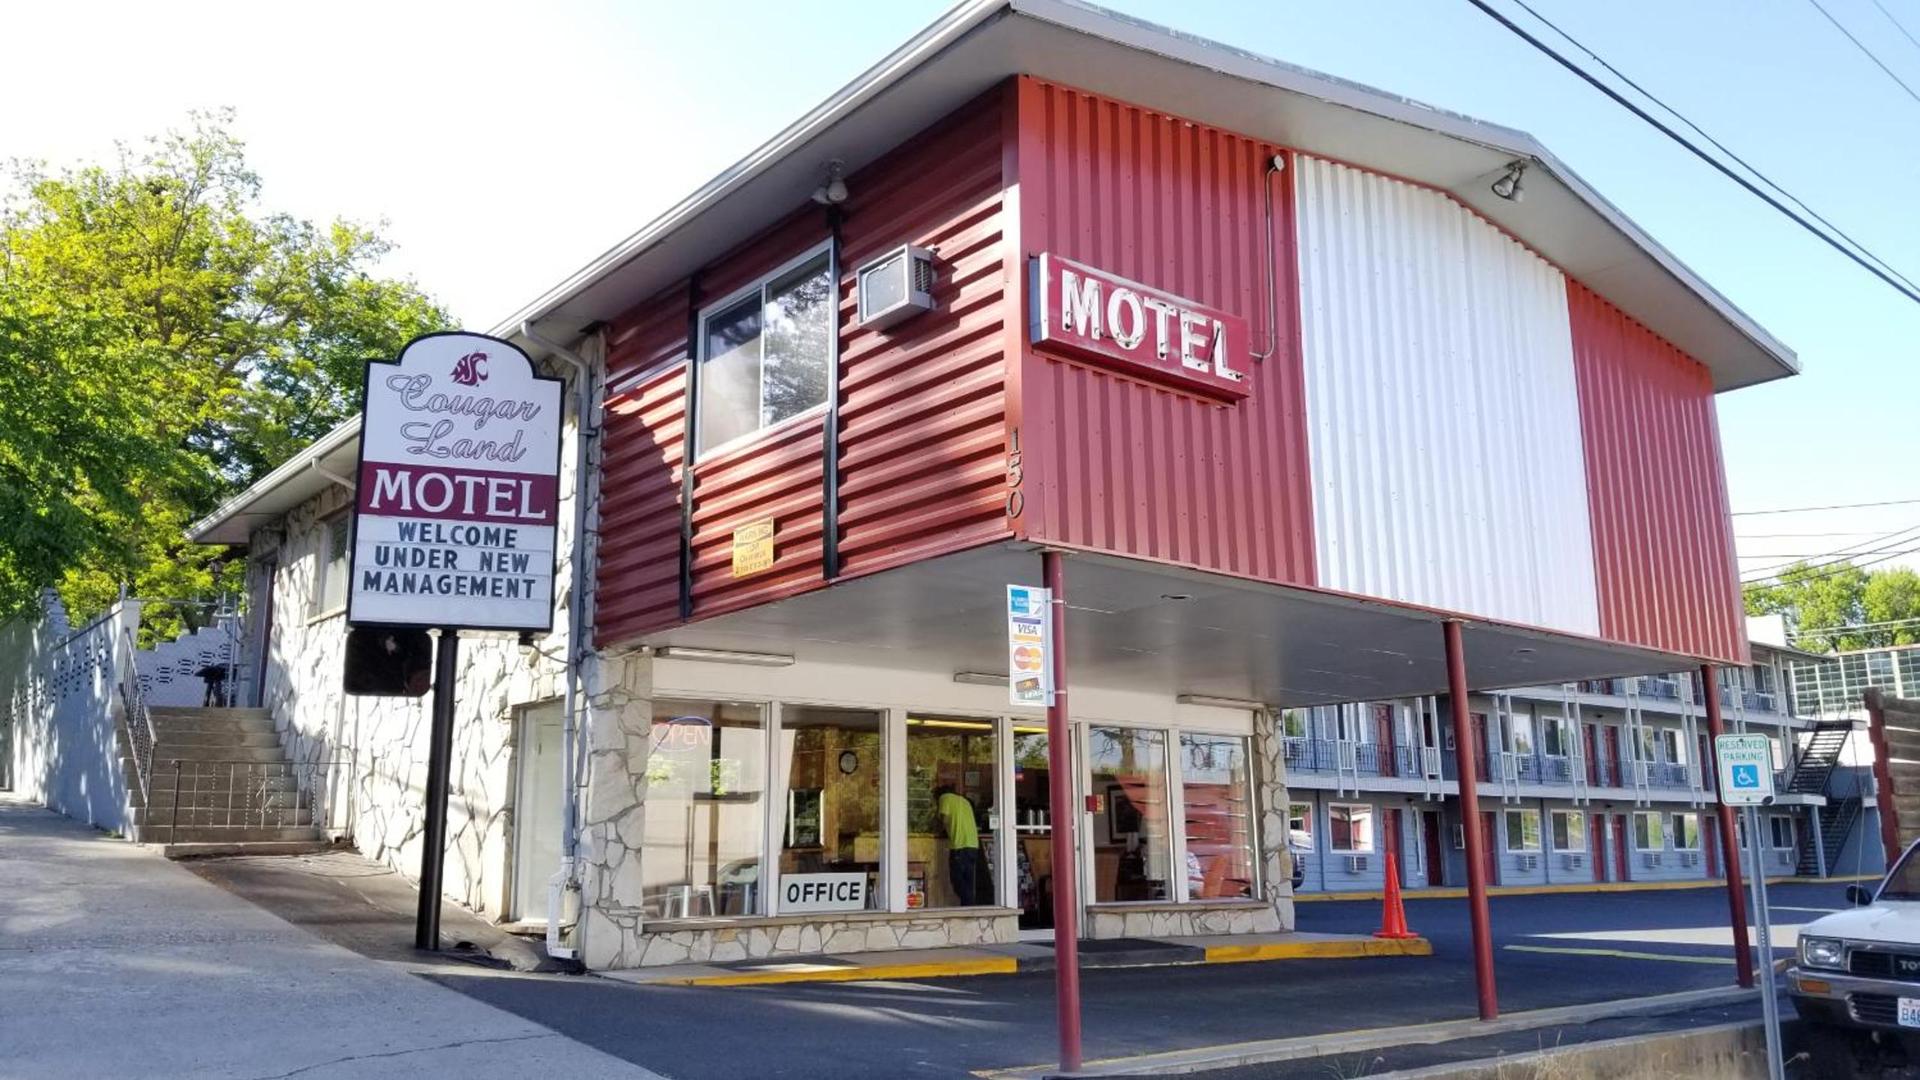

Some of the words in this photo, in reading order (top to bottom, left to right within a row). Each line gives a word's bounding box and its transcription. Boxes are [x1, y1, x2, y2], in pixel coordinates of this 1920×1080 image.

[1061, 268, 1242, 383] MOTEL
[386, 373, 541, 430] Cougar
[400, 419, 527, 462] Land
[369, 469, 547, 520] MOTEL
[398, 522, 518, 548] WELCOME
[374, 546, 458, 570] UNDER
[479, 551, 530, 574] NEW
[363, 571, 536, 598] MANAGEMENT
[1018, 624, 1038, 635] VISA
[652, 722, 710, 748] OPEN
[1718, 739, 1765, 750] RESERVED
[1723, 751, 1764, 760] PARKING
[787, 882, 861, 903] OFFICE
[1899, 960, 1920, 971] TO
